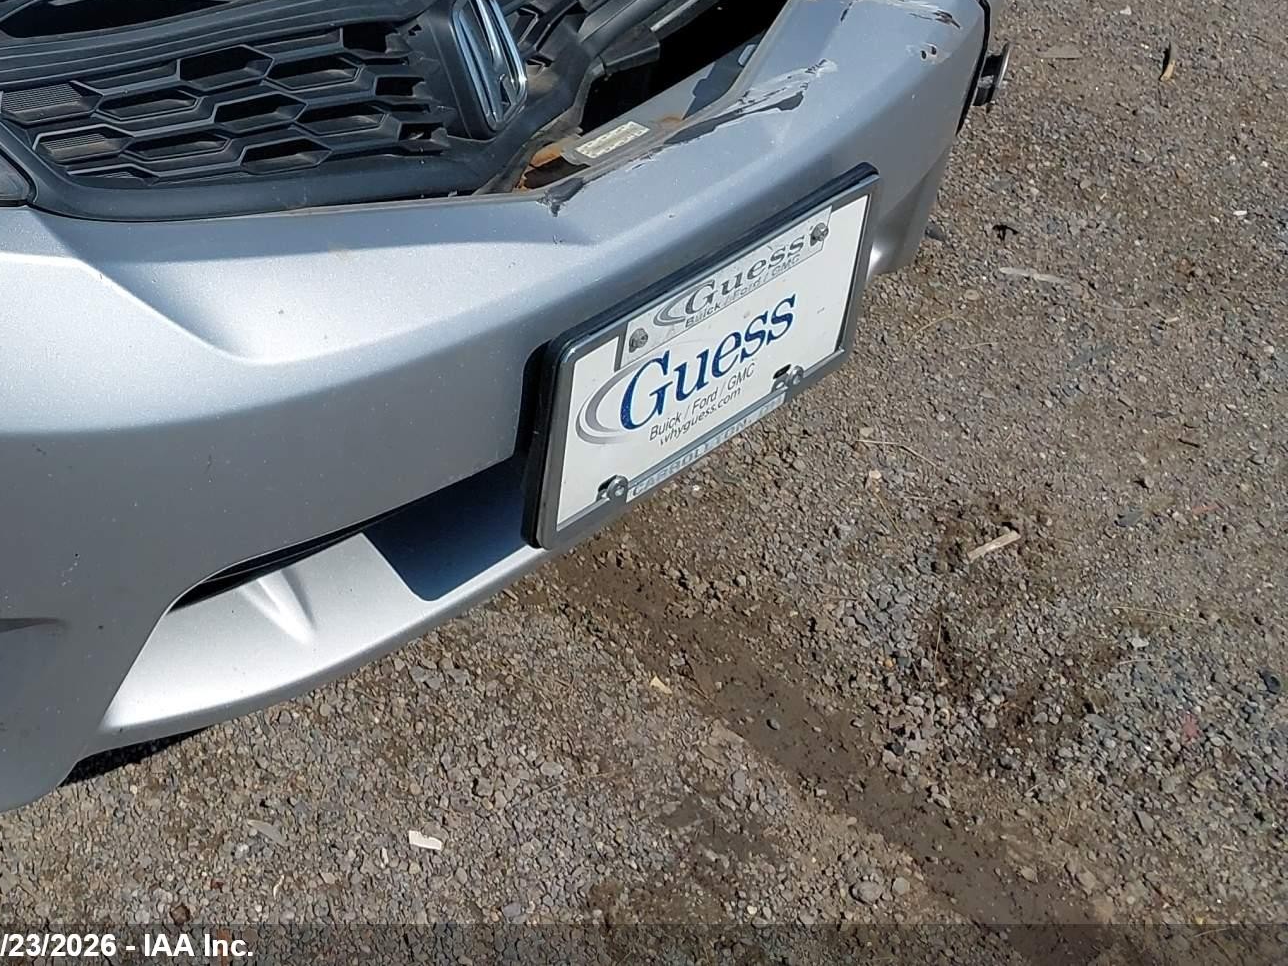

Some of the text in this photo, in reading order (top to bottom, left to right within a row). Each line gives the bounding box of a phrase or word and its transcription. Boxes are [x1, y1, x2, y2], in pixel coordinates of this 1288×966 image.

[685, 235, 805, 315] Guess
[685, 303, 721, 328] Buick
[732, 276, 762, 302] Ford
[771, 254, 800, 278] GMC
[620, 293, 796, 430] Guess
[649, 411, 683, 442] Buick
[691, 385, 719, 416] Ford
[727, 362, 756, 389] GMC
[660, 387, 742, 447] whyguess.com
